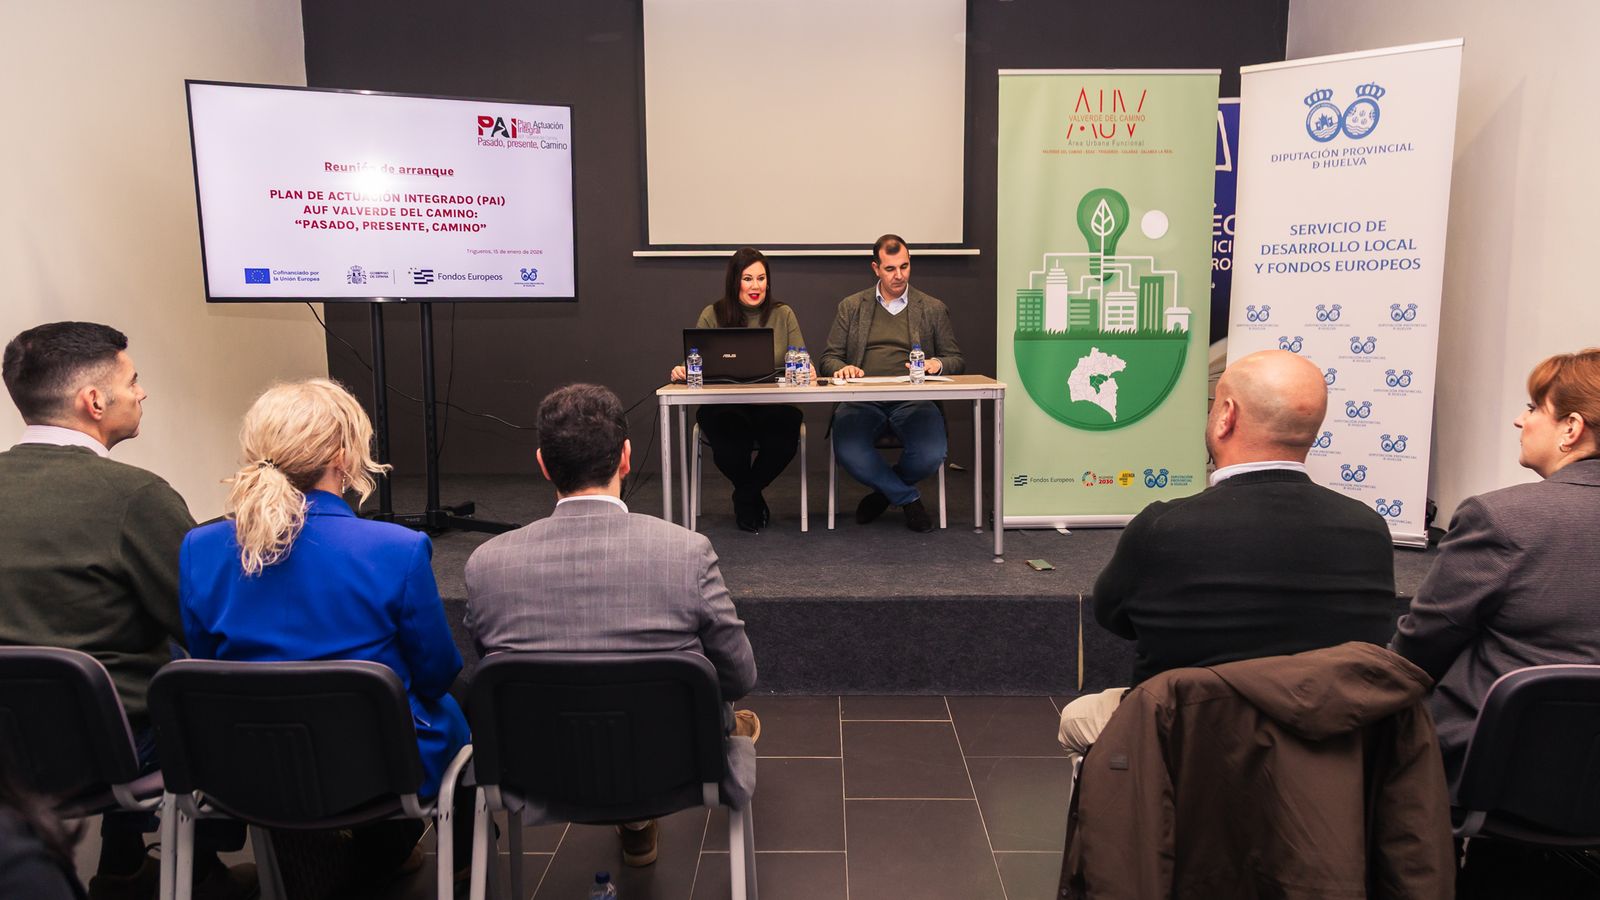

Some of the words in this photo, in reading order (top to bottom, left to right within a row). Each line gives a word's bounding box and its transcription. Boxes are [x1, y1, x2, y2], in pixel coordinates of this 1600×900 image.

[518, 126, 541, 135] Integral
[533, 121, 564, 130] Actuación
[478, 137, 505, 148] Pasado,
[507, 140, 539, 149] presente,
[540, 140, 568, 150] Camino
[1271, 148, 1338, 163] DIPUTACIÓN
[1342, 142, 1414, 157] PROVINCIAL
[1323, 157, 1367, 169] HUELVA
[399, 165, 454, 178] arranque
[270, 190, 303, 200] PLAN
[307, 191, 324, 201] DE
[328, 190, 401, 203] ACTUACIÓN
[404, 194, 474, 205] INTEGRADO
[303, 206, 328, 215] AUF
[333, 206, 396, 217] VALVERDE
[400, 208, 423, 217] DEL
[426, 208, 478, 218] CAMINO:
[362, 221, 430, 233] PRESENTE,
[1290, 221, 1361, 236] SERVICIO
[1366, 220, 1387, 232] DE
[1261, 240, 1360, 256] DESARROLLO
[1364, 238, 1417, 252] LOCAL
[1255, 263, 1263, 274] Y
[1268, 261, 1331, 274] FONDOS
[1335, 258, 1421, 272] EUROPEOS
[438, 273, 466, 281] Fondos
[468, 273, 503, 282] Europeos
